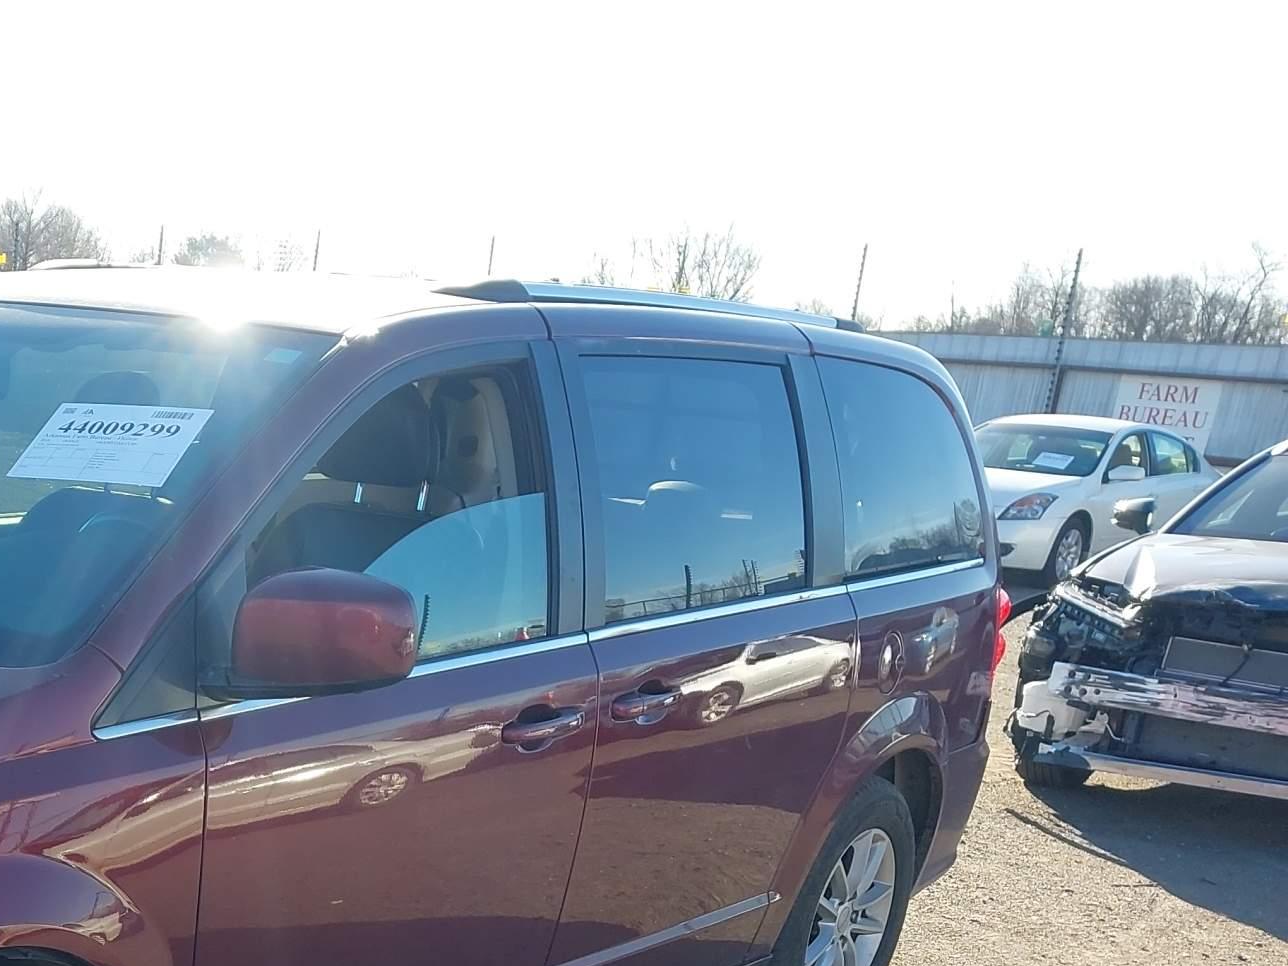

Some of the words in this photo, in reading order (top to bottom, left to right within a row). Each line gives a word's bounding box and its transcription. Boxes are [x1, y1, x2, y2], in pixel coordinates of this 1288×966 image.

[1138, 382, 1199, 404] FARM
[1119, 404, 1209, 429] BUREAU
[58, 420, 181, 438] 44009299
